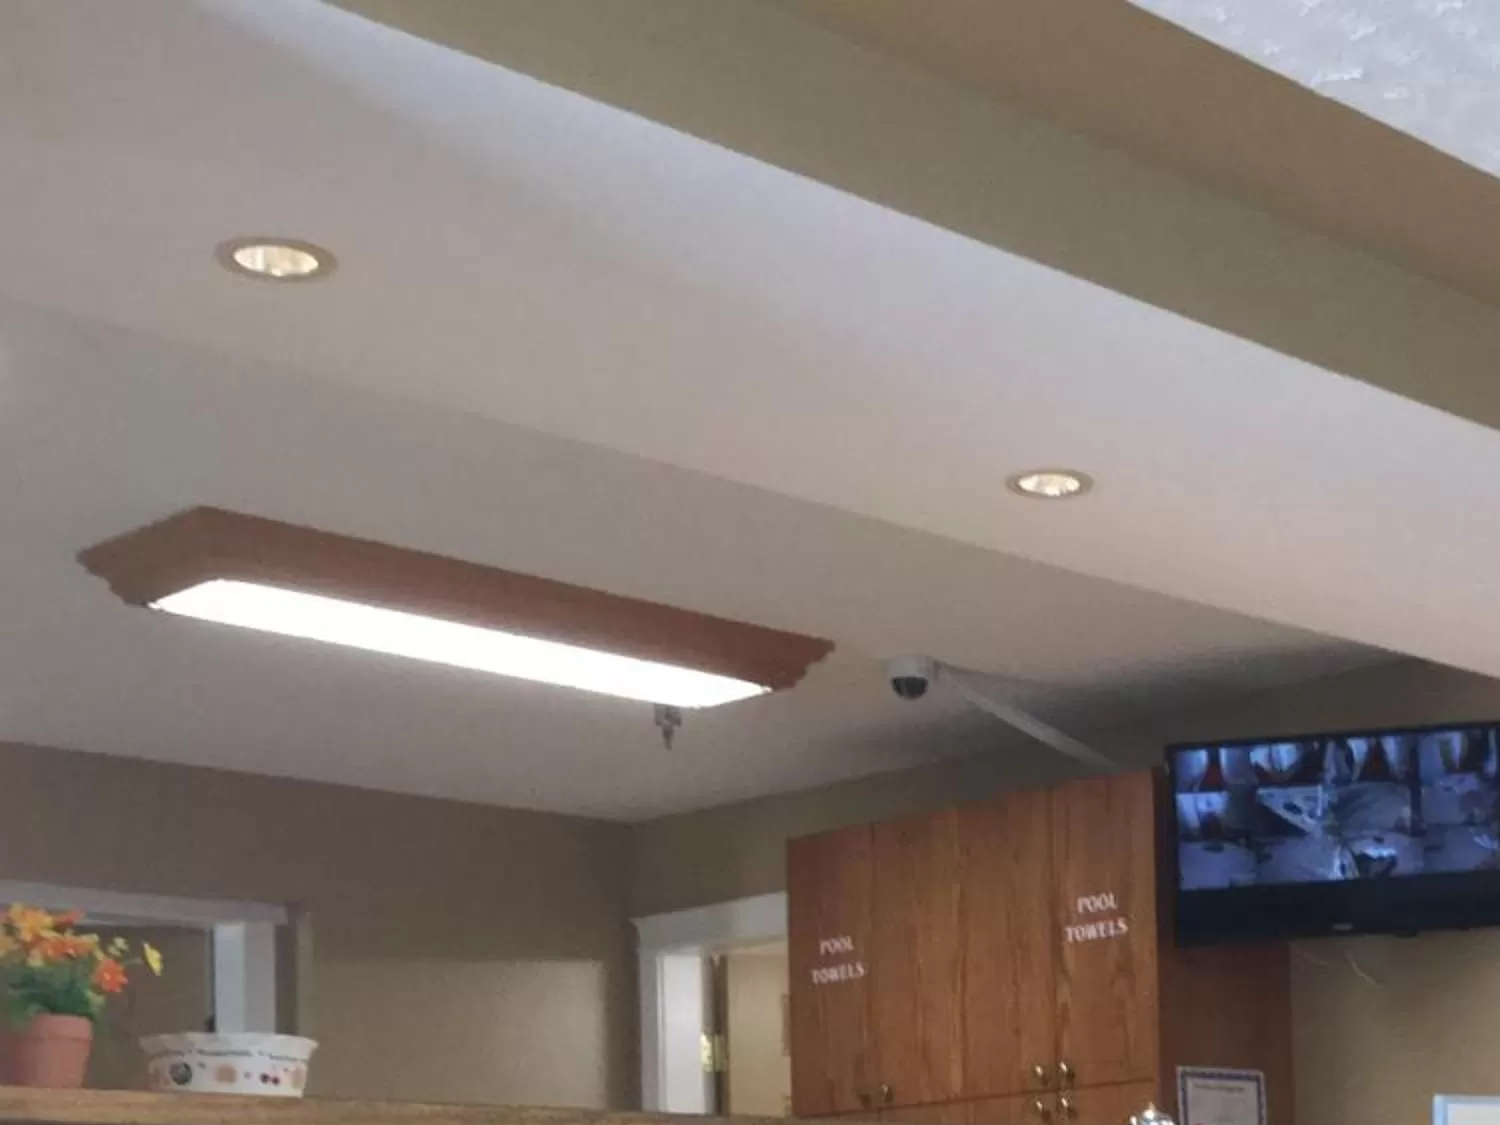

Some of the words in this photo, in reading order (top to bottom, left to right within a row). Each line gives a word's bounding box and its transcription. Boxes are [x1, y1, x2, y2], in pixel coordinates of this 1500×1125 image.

[1077, 892, 1118, 914] POOL
[1065, 917, 1129, 944] TOWELS
[819, 935, 855, 956] POOL
[810, 961, 867, 985] TOWELS
